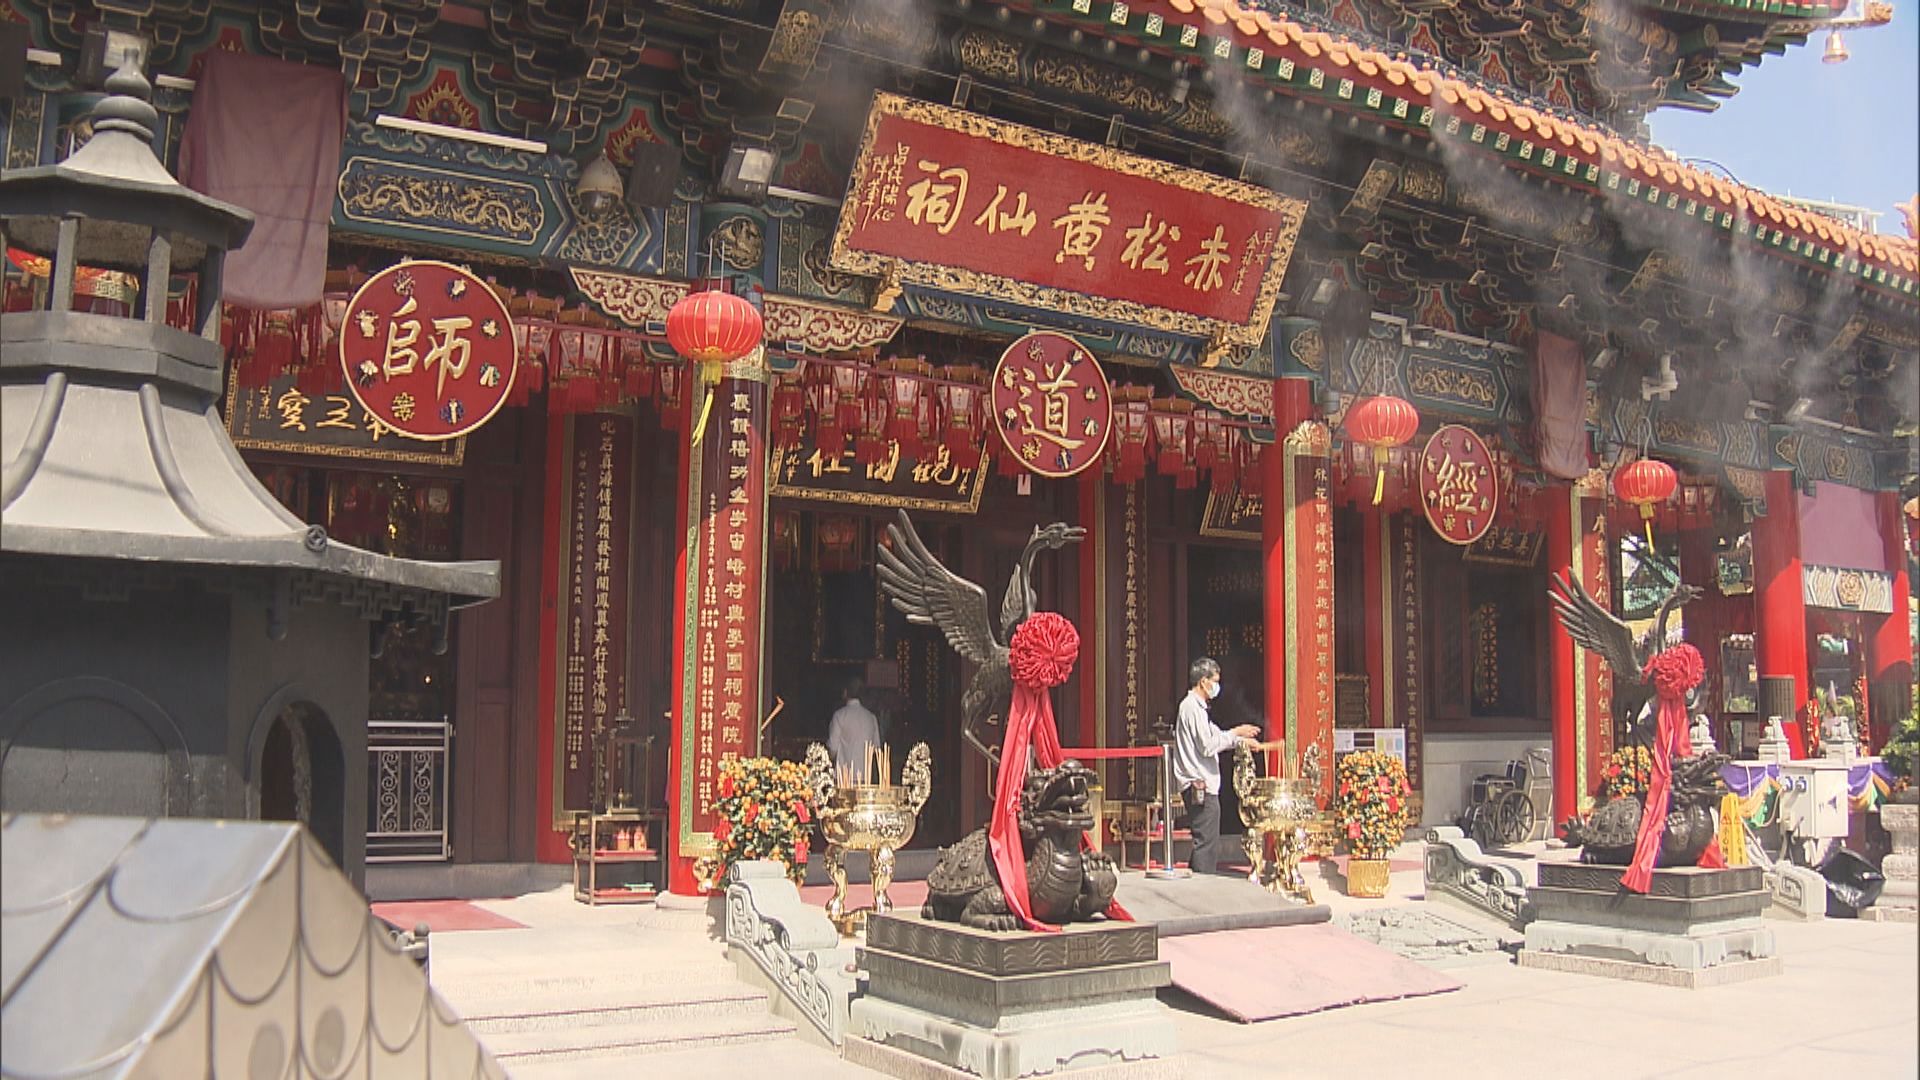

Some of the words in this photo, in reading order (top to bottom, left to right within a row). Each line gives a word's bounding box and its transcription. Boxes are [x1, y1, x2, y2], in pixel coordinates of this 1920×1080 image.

[383, 297, 473, 401] 師
[1018, 361, 1085, 449] 道
[1436, 453, 1477, 514] 經
